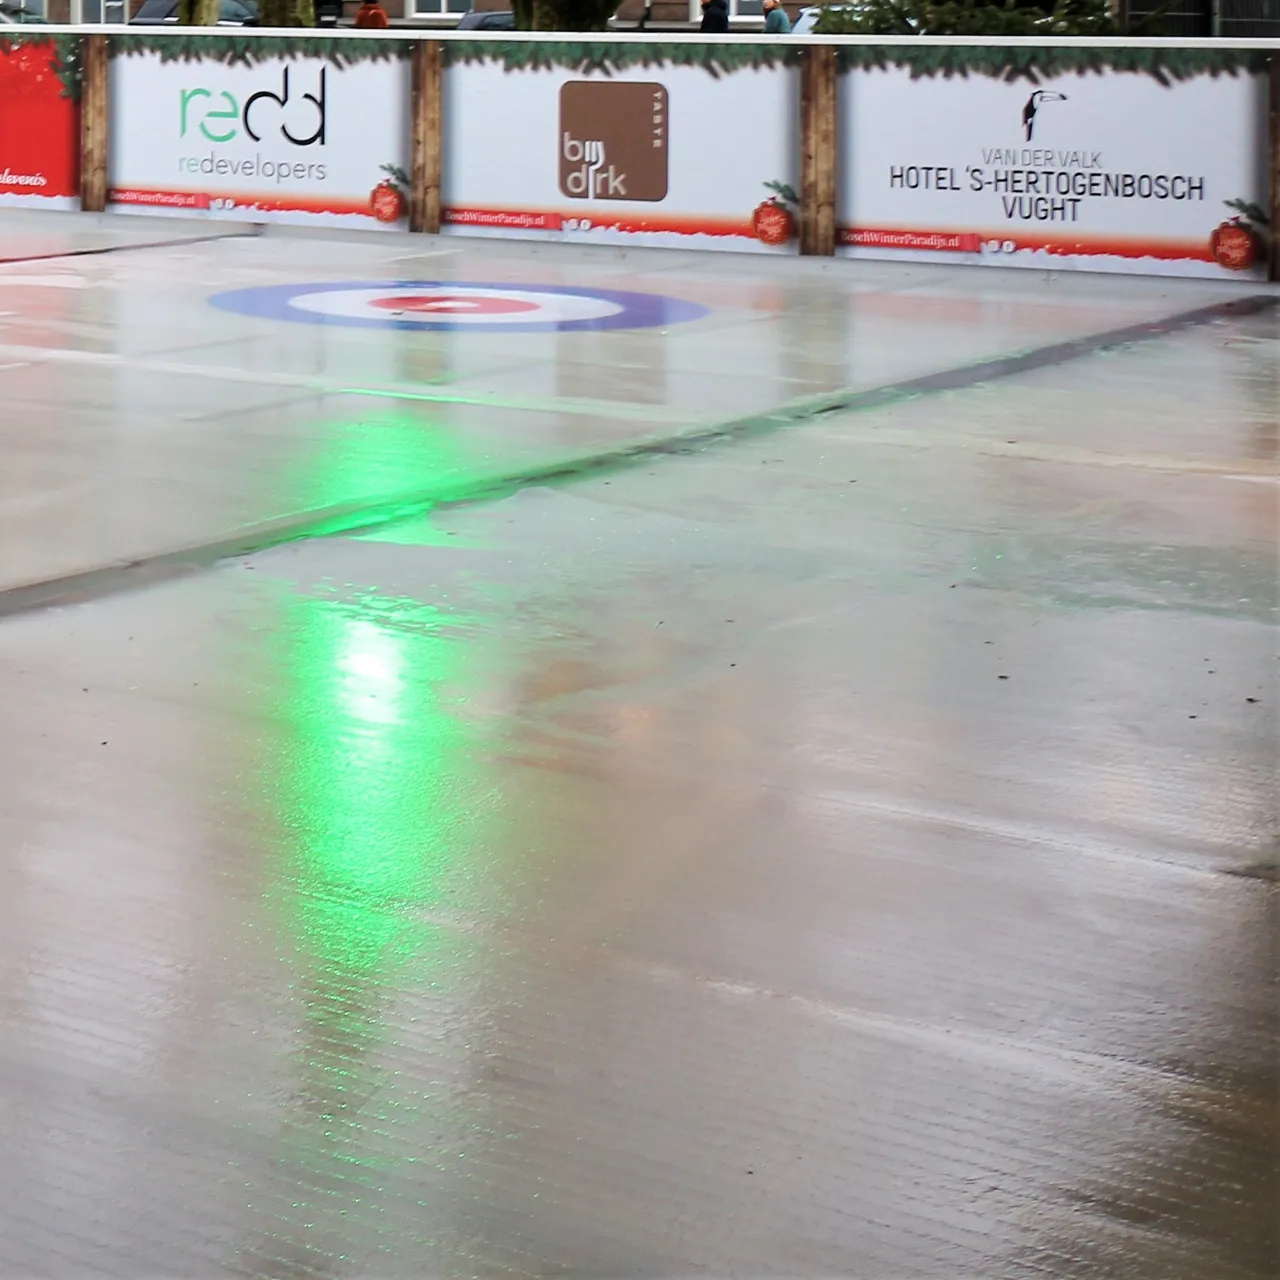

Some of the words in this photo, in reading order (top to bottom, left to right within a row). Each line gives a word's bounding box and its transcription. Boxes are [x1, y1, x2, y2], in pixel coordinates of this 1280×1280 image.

[178, 150, 327, 184] redevelopers
[981, 148, 1017, 166] VAN
[1020, 149, 1054, 167] DER
[1058, 151, 1103, 169] VALK
[566, 164, 627, 200] dirk
[889, 165, 961, 192] HOTEL
[1001, 195, 1082, 222] VUGHT
